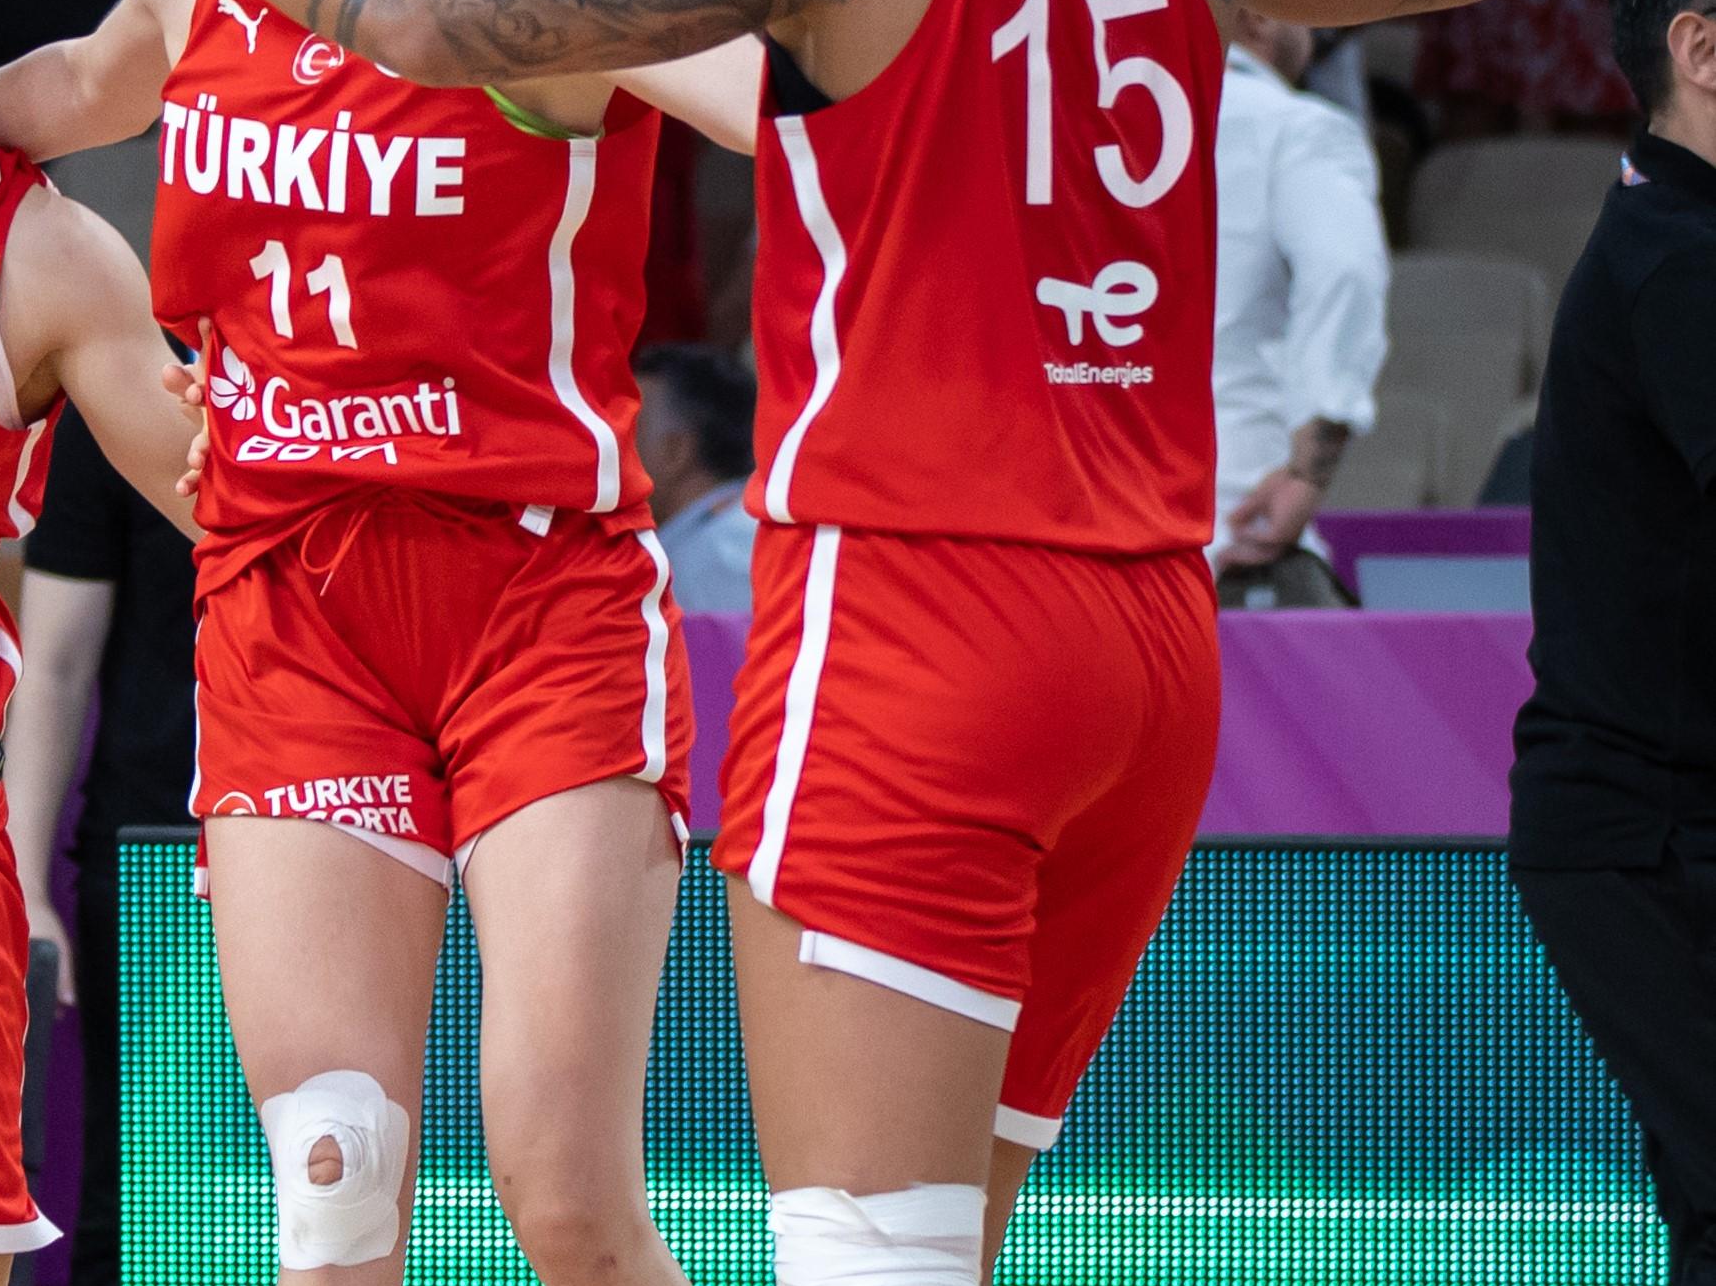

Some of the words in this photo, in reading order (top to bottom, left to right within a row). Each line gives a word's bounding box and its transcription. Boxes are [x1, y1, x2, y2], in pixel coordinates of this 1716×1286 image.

[161, 93, 466, 217] TÜRKİYE
[248, 240, 358, 350] 11
[262, 376, 461, 441] Garanti
